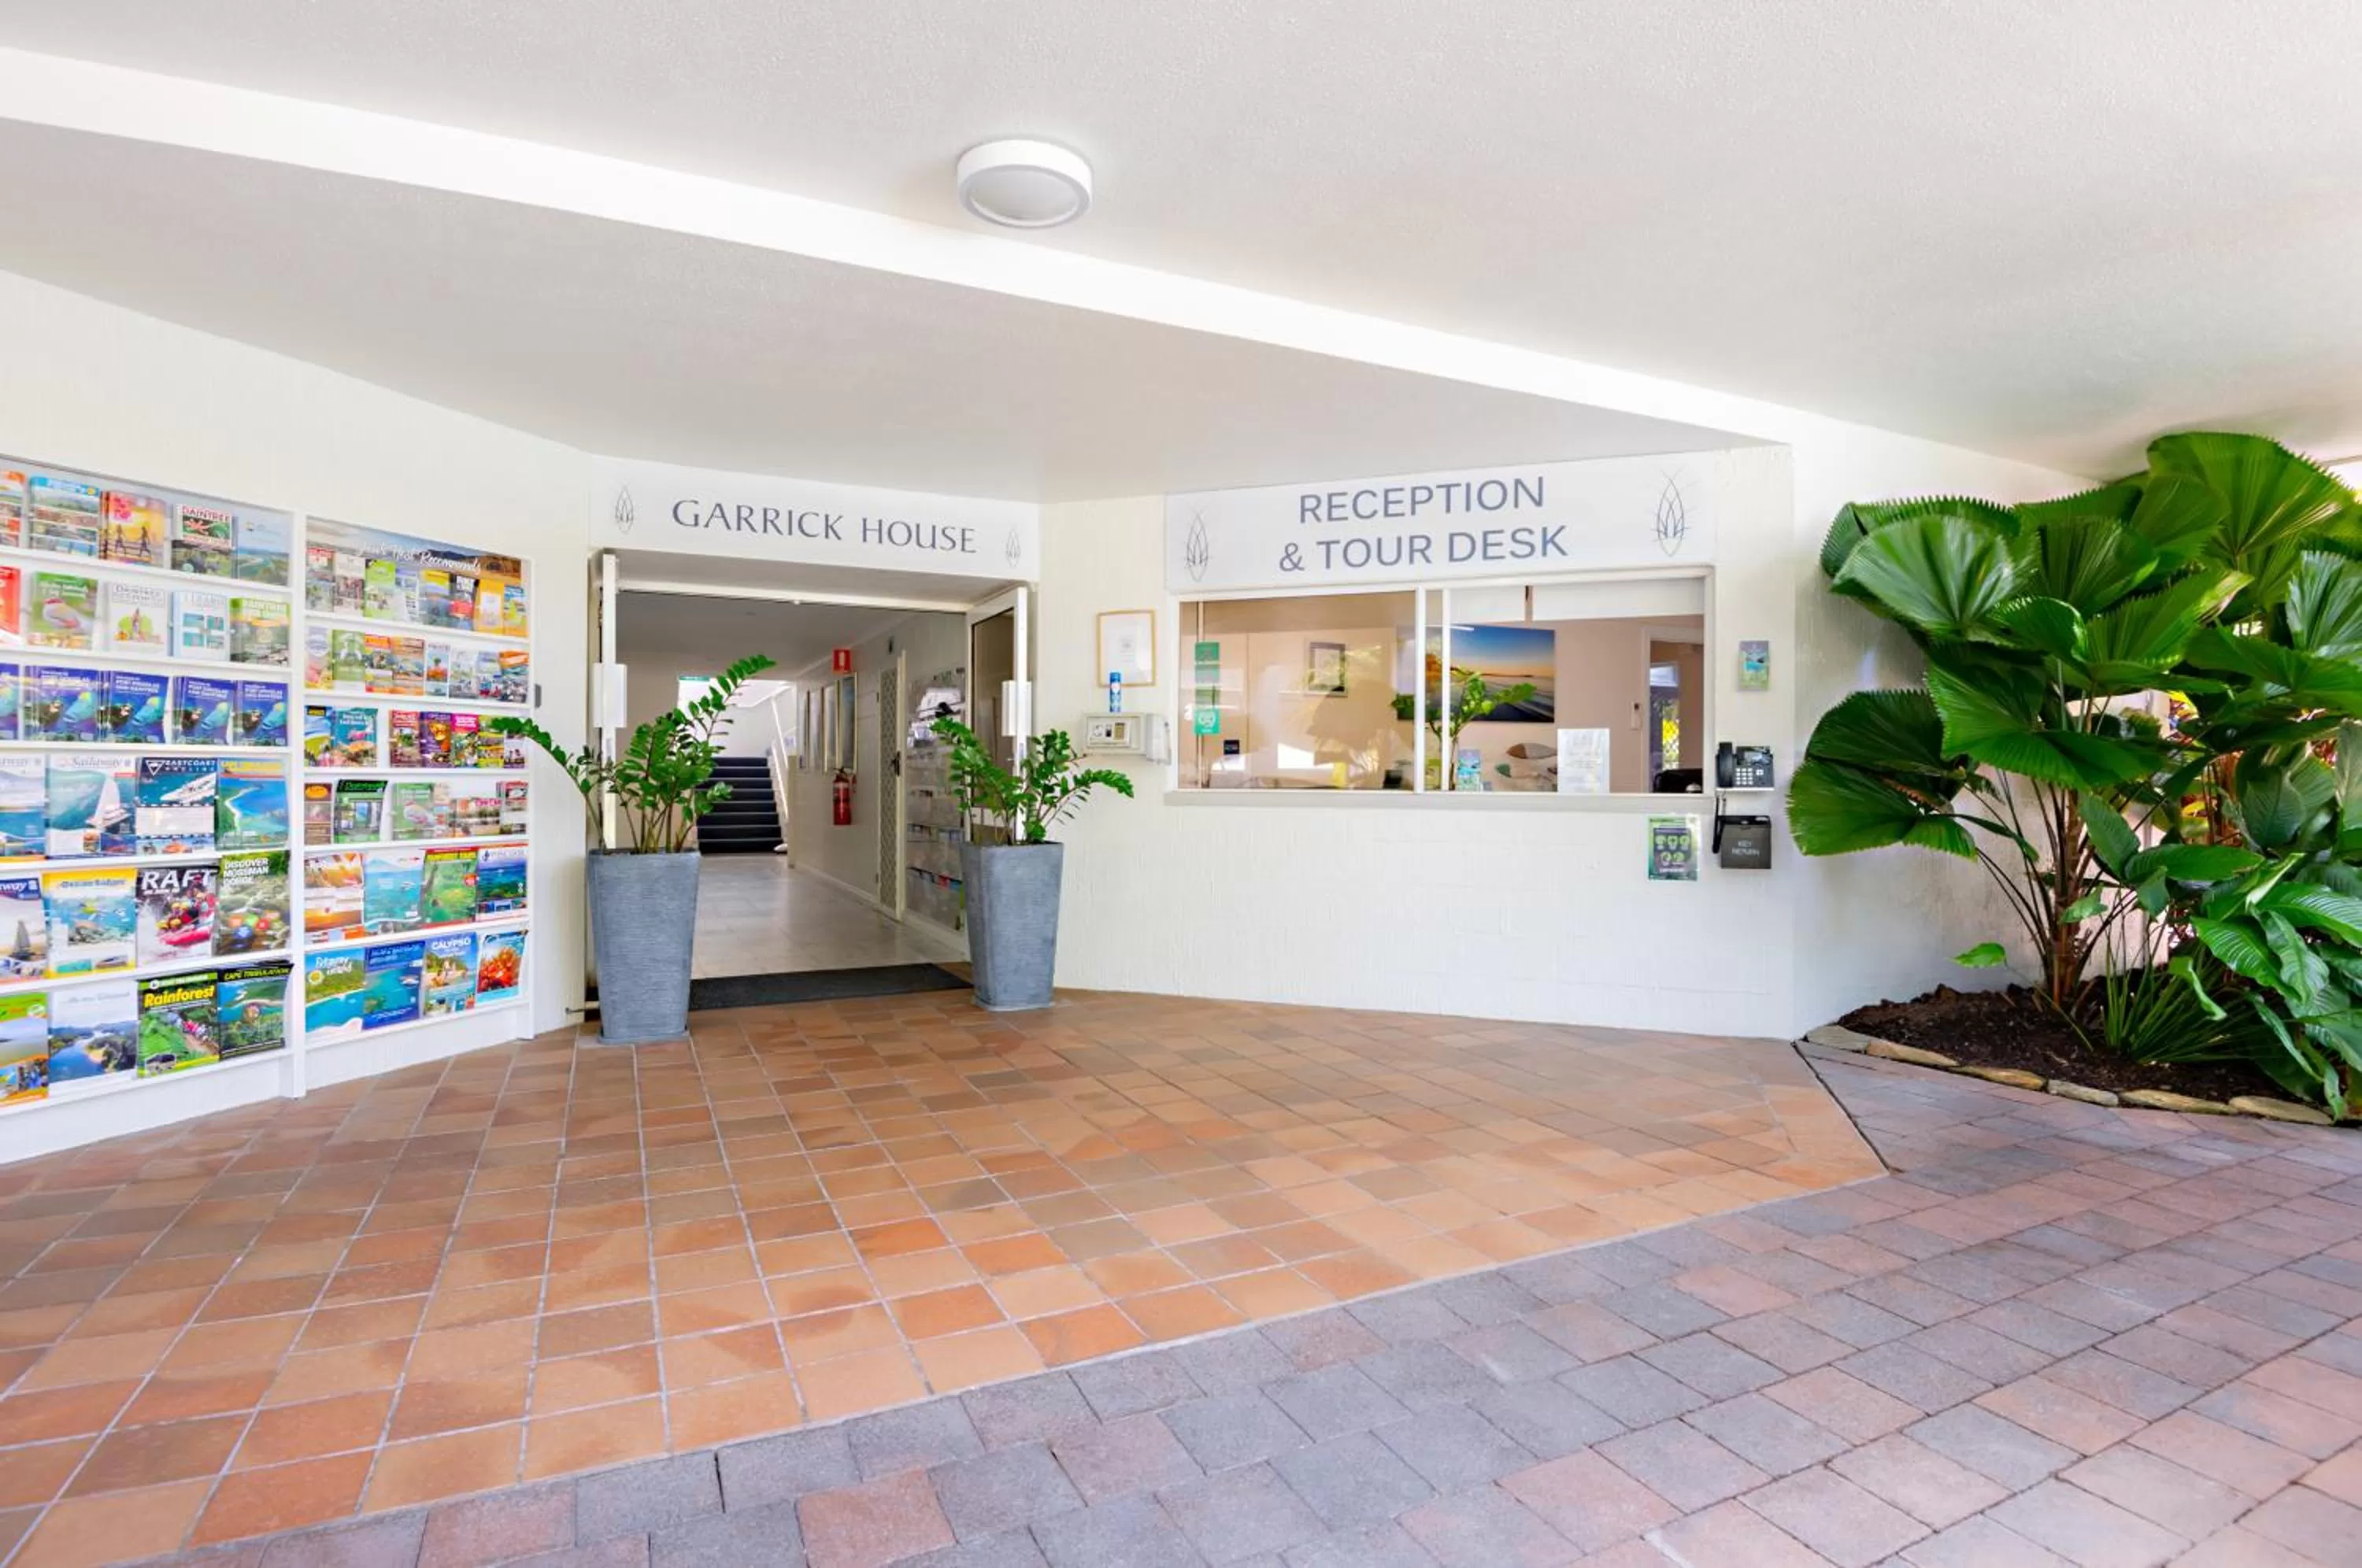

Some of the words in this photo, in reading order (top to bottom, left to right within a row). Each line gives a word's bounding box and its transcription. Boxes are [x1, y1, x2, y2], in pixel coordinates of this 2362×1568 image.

[1299, 476, 1545, 524] RECEPTION
[181, 505, 231, 523] DAINTREE
[672, 498, 845, 542] GARRICK
[861, 516, 978, 554] HOUSE
[1278, 542, 1305, 572] &
[1316, 534, 1433, 570] TOUR
[1447, 524, 1568, 564] DESK
[224, 858, 268, 870] DISCOVER
[141, 868, 218, 891] RAFT
[431, 936, 472, 950] CALYPSO
[143, 985, 215, 1008] Rainforest
